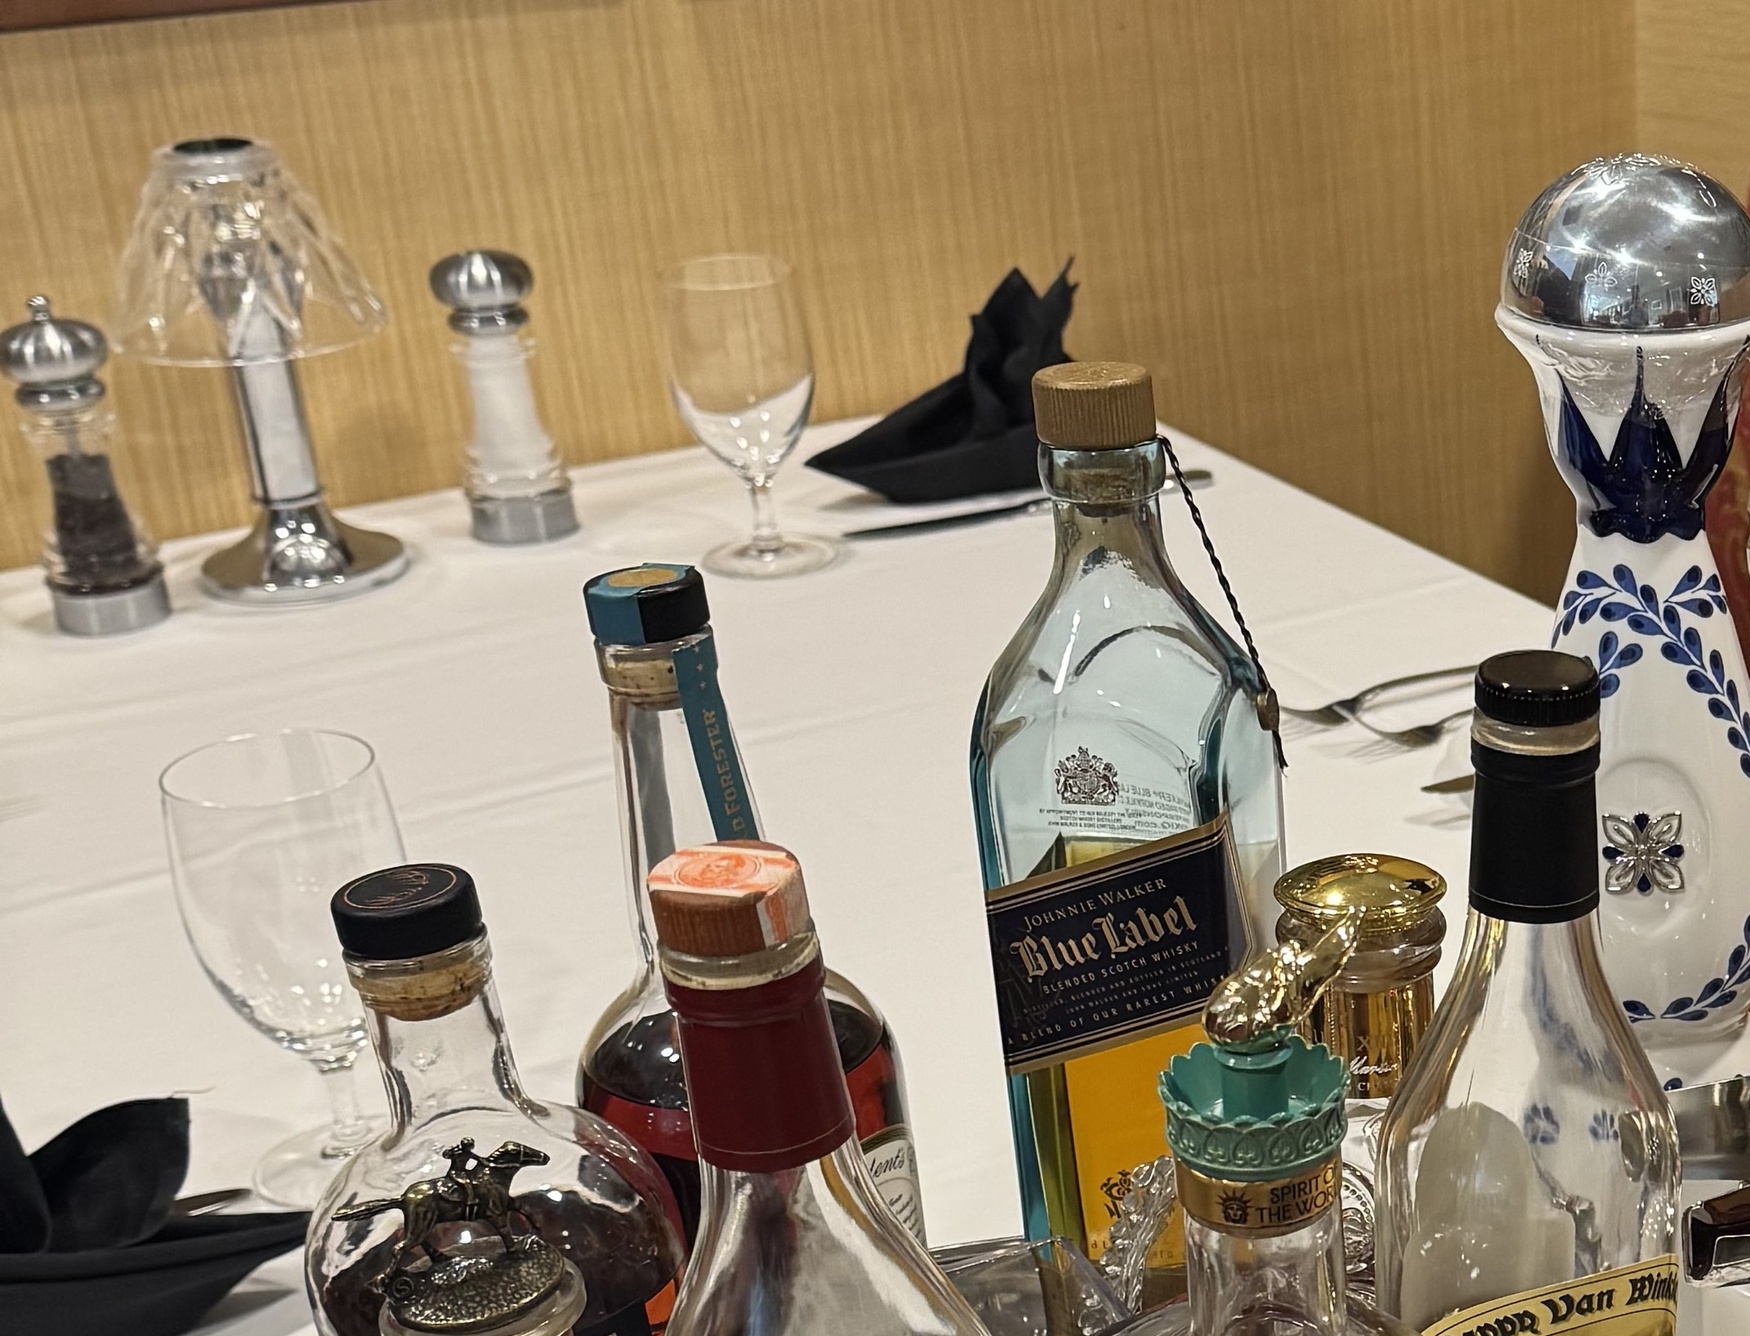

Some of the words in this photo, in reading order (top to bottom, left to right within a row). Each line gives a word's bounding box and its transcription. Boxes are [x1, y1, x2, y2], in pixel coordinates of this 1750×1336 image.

[702, 709, 741, 816] FORESTER
[1024, 899, 1097, 933] JOHNNIE
[1098, 878, 1167, 906] WALKER
[1009, 932, 1102, 984] Blue
[1092, 895, 1199, 960] Label
[1043, 972, 1096, 994] BLENDED
[1100, 957, 1148, 978] SCOTCH
[1151, 940, 1199, 962] WHISKY
[1021, 1024, 1061, 1041] BLEND
[1069, 1016, 1084, 1028] OF
[1092, 1008, 1118, 1021] OUR
[1126, 990, 1176, 1012] RAREST
[1183, 975, 1224, 994] WHIS
[1256, 1203, 1293, 1224] THE
[1269, 1175, 1320, 1204] SPIRIT
[1541, 1287, 1618, 1325] Van
